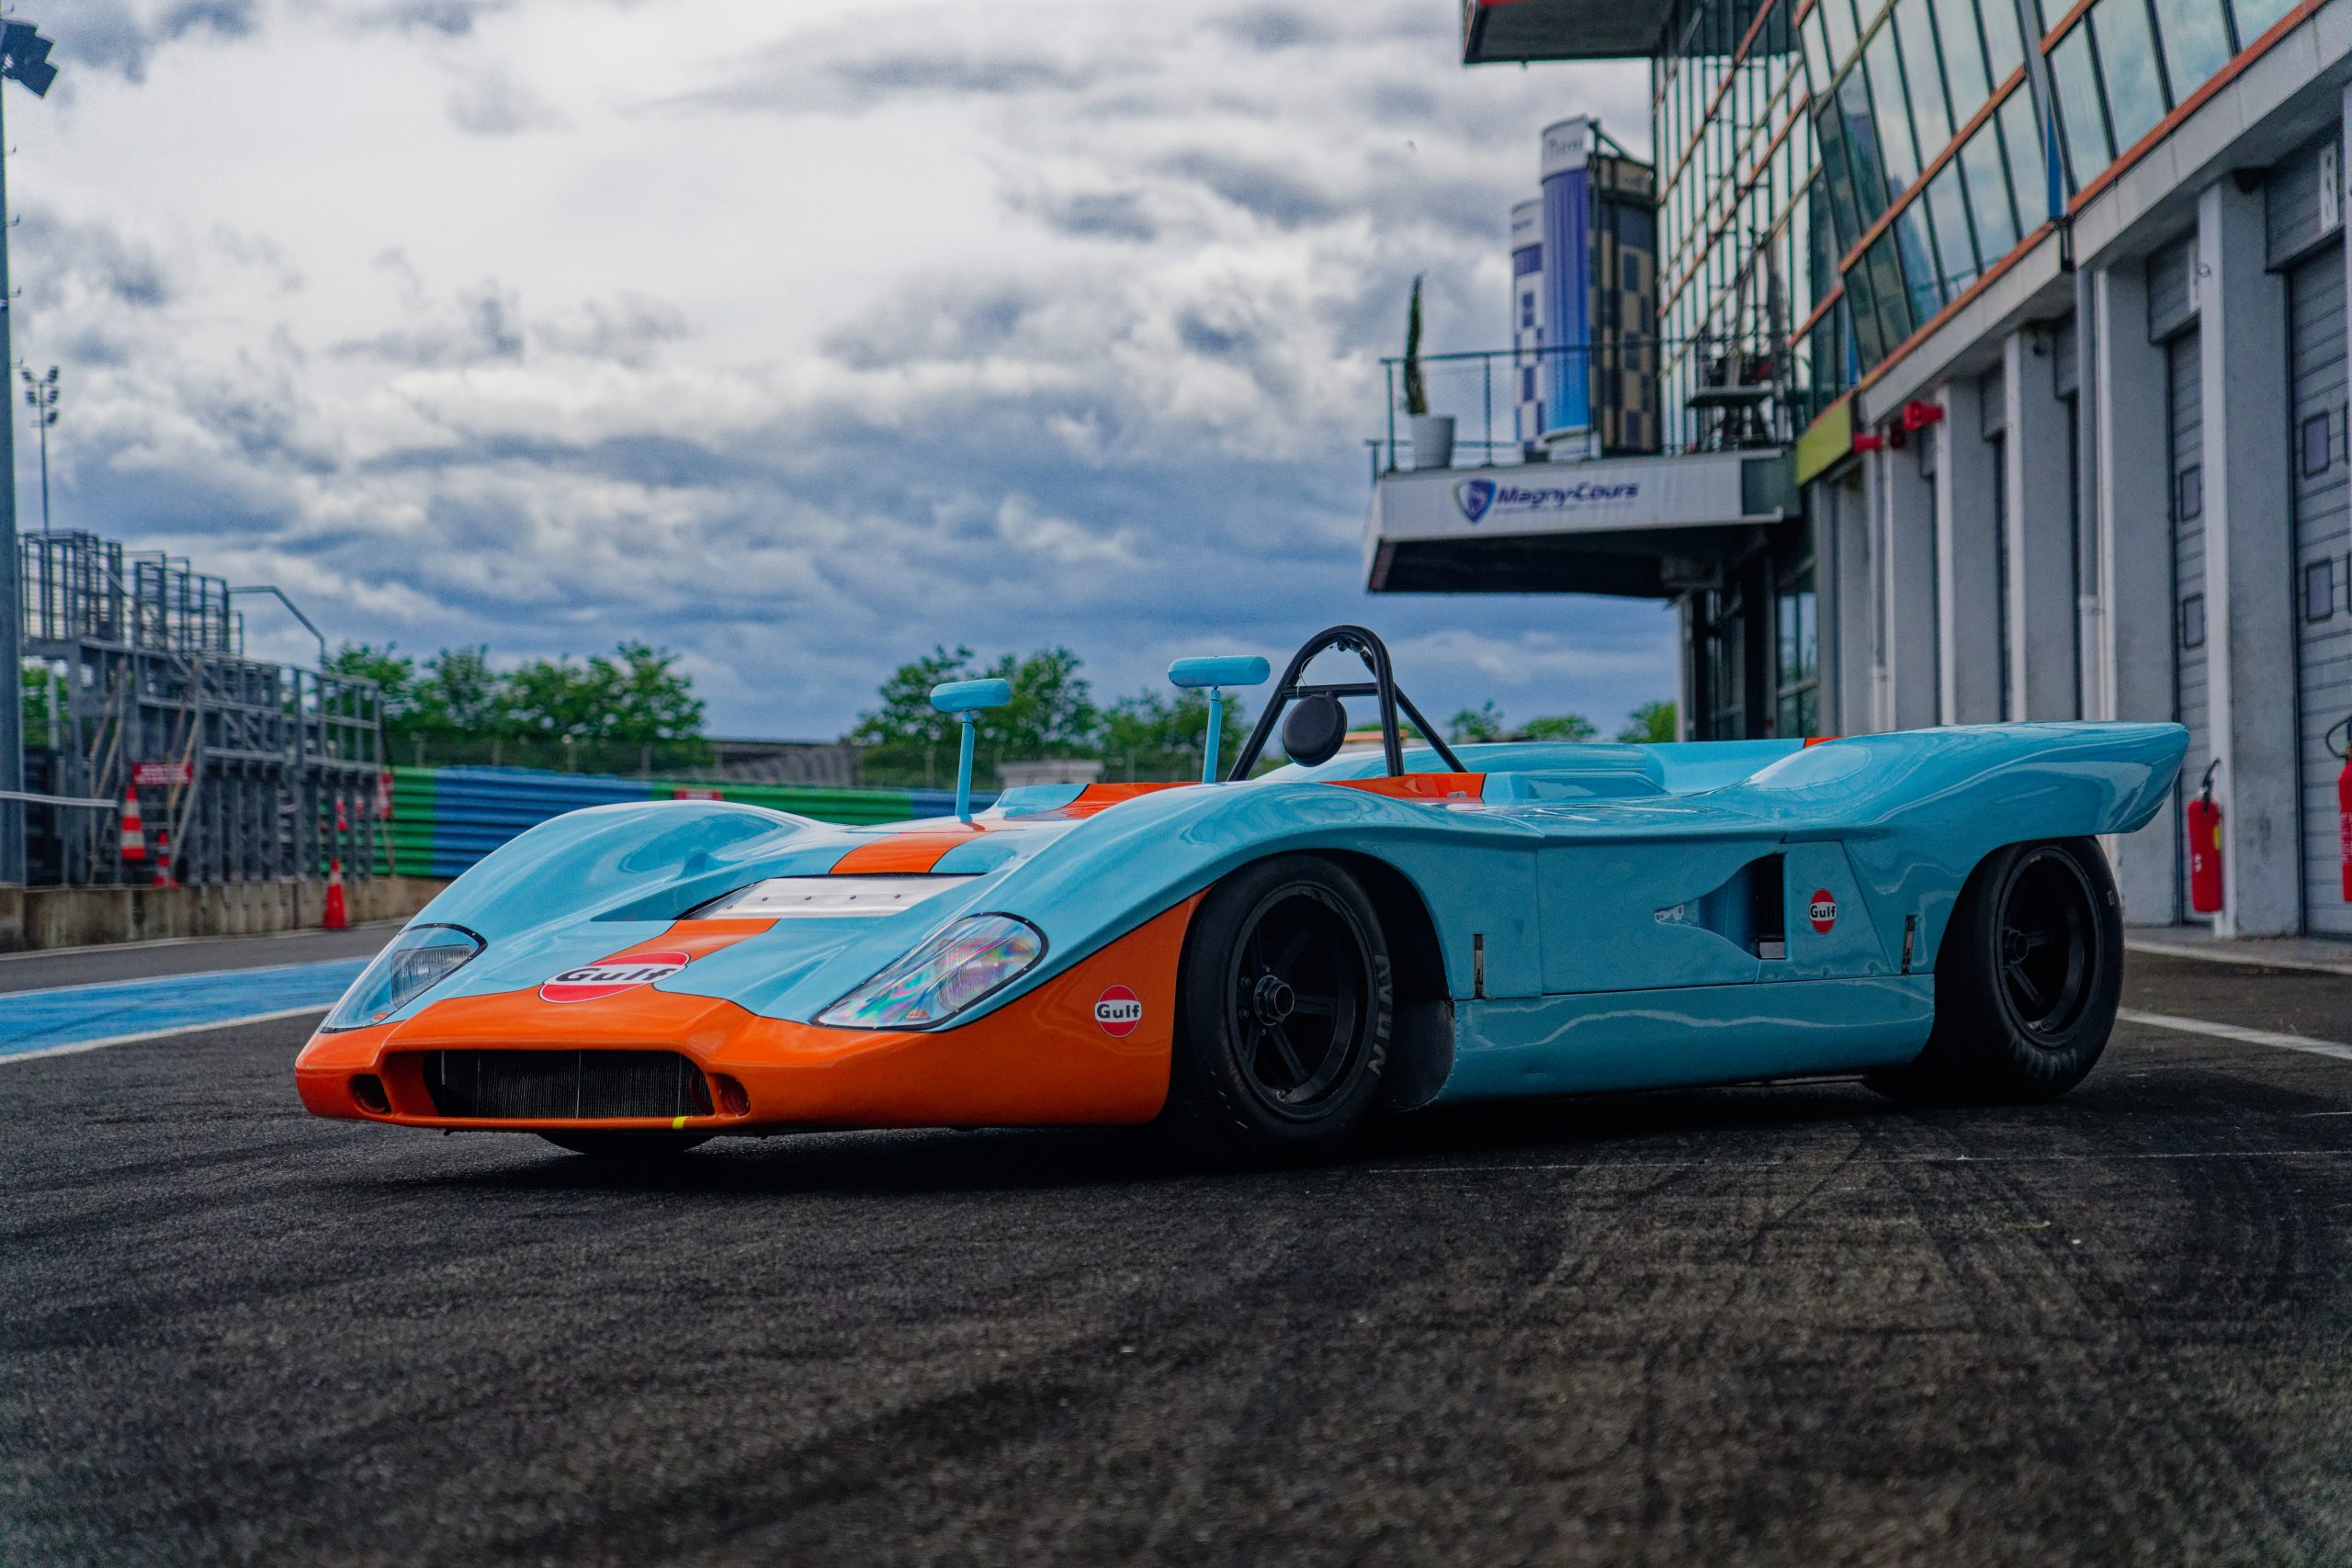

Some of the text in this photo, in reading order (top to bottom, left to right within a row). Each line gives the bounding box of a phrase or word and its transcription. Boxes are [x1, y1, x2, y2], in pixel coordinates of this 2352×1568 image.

[1810, 905, 1837, 919] Gulf
[555, 967, 678, 982] Gulf
[1096, 1003, 1140, 1019] Gulf
